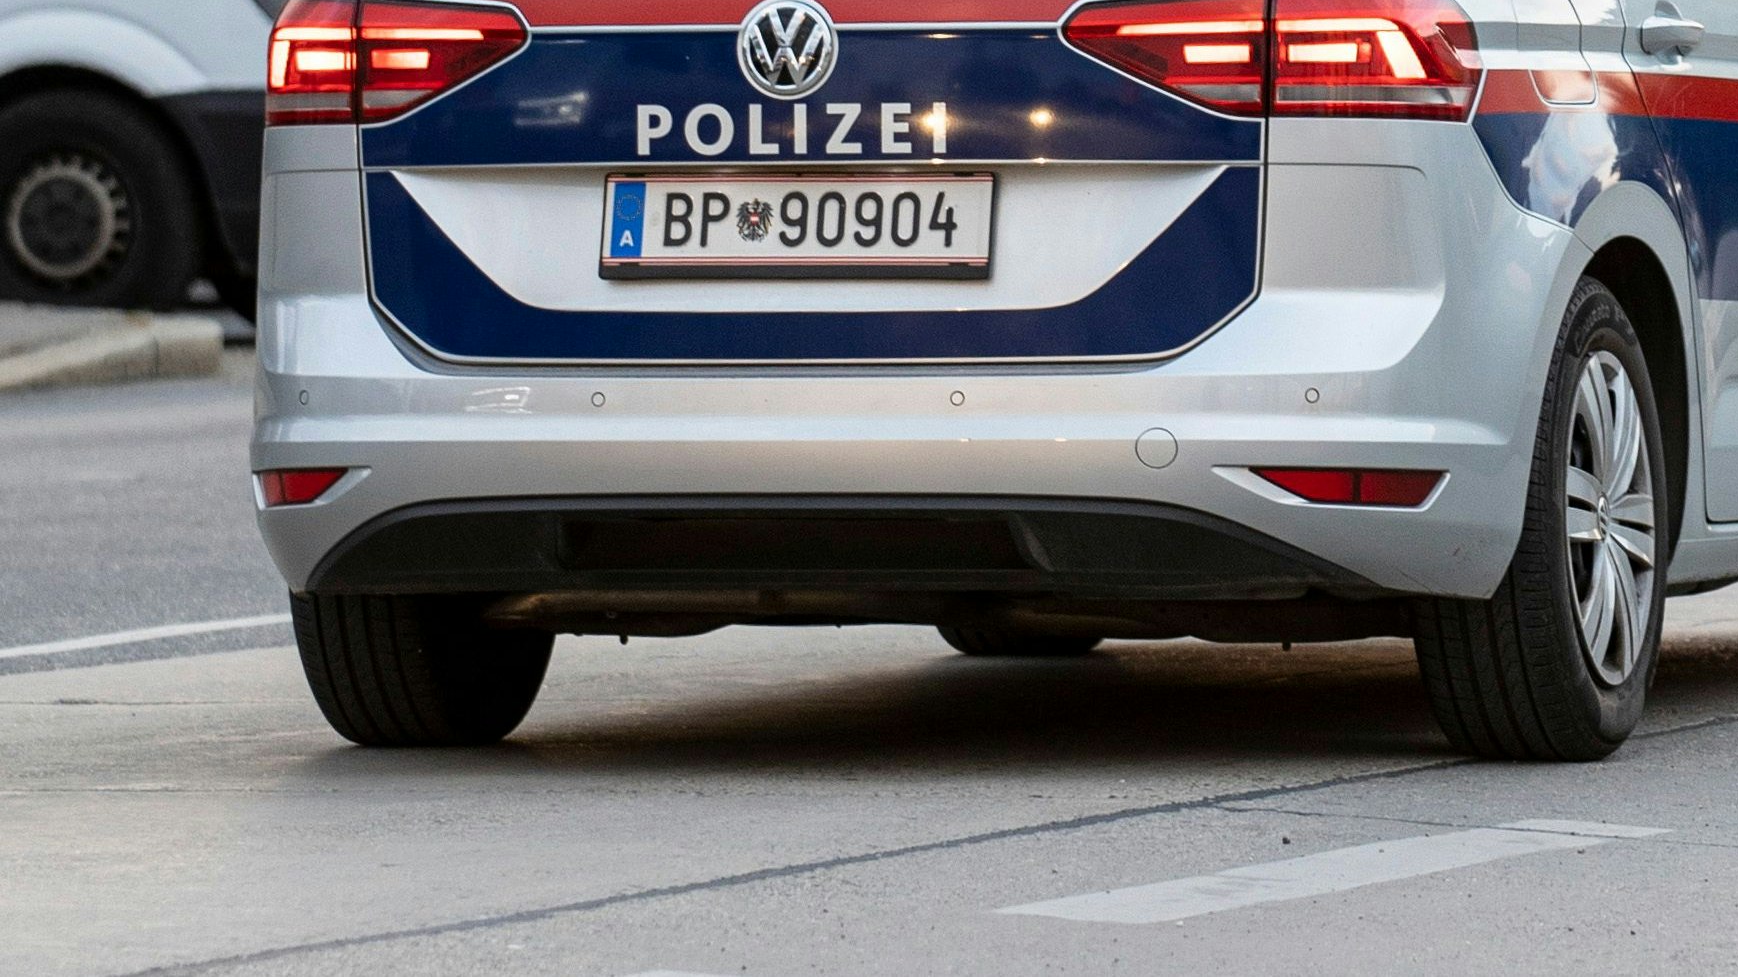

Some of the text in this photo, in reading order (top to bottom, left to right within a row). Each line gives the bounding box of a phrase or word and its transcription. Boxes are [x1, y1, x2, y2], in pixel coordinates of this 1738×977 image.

[637, 101, 947, 156] POLIZEI
[619, 229, 634, 248] A
[662, 190, 958, 249] BP 90904
